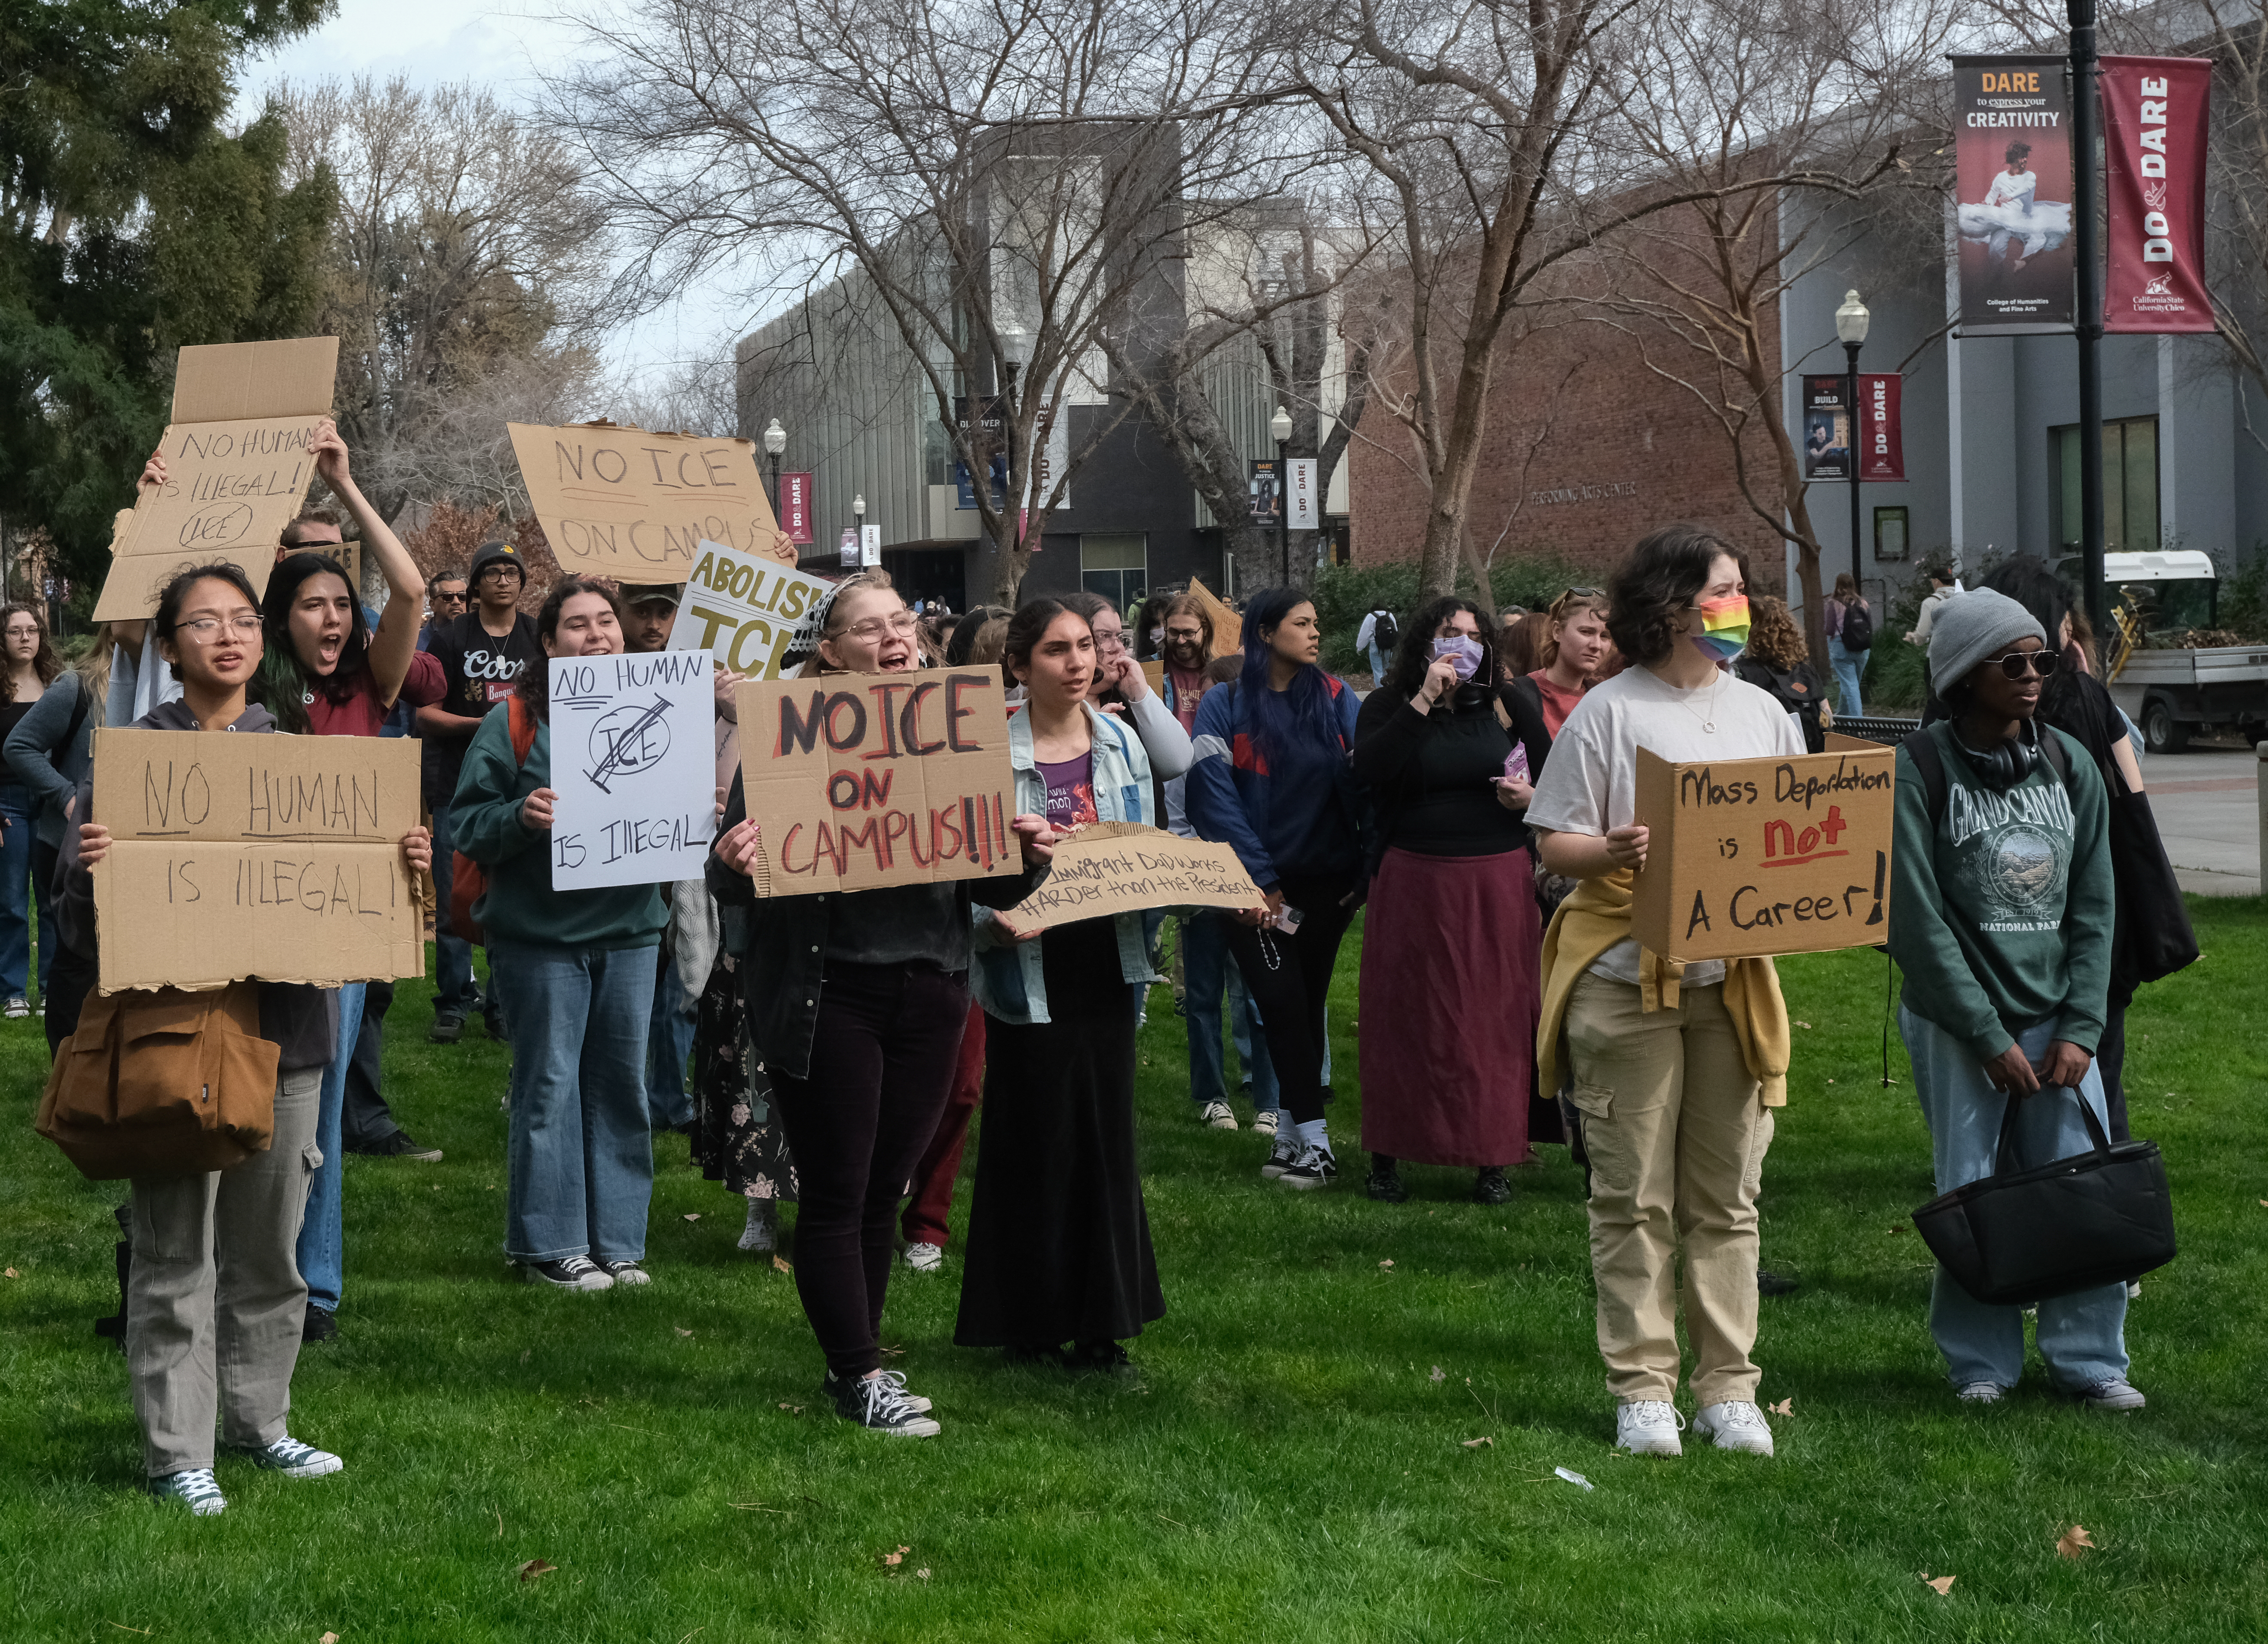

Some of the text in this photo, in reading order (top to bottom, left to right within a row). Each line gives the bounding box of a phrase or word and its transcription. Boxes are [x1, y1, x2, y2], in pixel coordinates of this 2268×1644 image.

[1982, 72, 2040, 92] DARE
[1989, 98, 2023, 107] express
[2024, 98, 2046, 107] your
[1967, 112, 2060, 127] CREATIVITY
[2140, 76, 2167, 178] DARE
[2143, 211, 2173, 263] DO
[2134, 304, 2164, 312] University
[1814, 396, 1838, 404] BUILD
[1874, 380, 1886, 421] DARE
[179, 434, 233, 459] NO
[1875, 434, 1888, 454] DO
[556, 440, 737, 488] NO ICE
[156, 480, 180, 498] IS
[792, 477, 801, 504] DARE
[1532, 481, 1635, 505] PERFORMING ARTS CENTER
[1299, 498, 1307, 511] DO
[793, 513, 802, 526] DO
[559, 519, 616, 556] ON
[1224, 615, 1241, 629] LISTEN
[1226, 627, 1232, 636] TO
[555, 655, 703, 697] NO HUMAN
[489, 685, 516, 700] Banque
[773, 690, 867, 758] NO
[860, 674, 992, 760] ICE
[827, 768, 894, 811] ON
[1681, 755, 1890, 810] Mass Deportation
[145, 760, 378, 837] NO HUMAN
[2005, 781, 2075, 841] CANYO
[780, 791, 1009, 877] CAMPUS!!!
[1718, 805, 1847, 859] is not
[553, 834, 586, 868] IS
[1175, 854, 1226, 872] Works
[168, 859, 201, 904] IS
[1107, 877, 1157, 897] than
[1157, 875, 1189, 891] the
[1185, 872, 1256, 895] President
[1686, 850, 1886, 941] A Career!
[1979, 922, 2035, 932] NATIONAL
